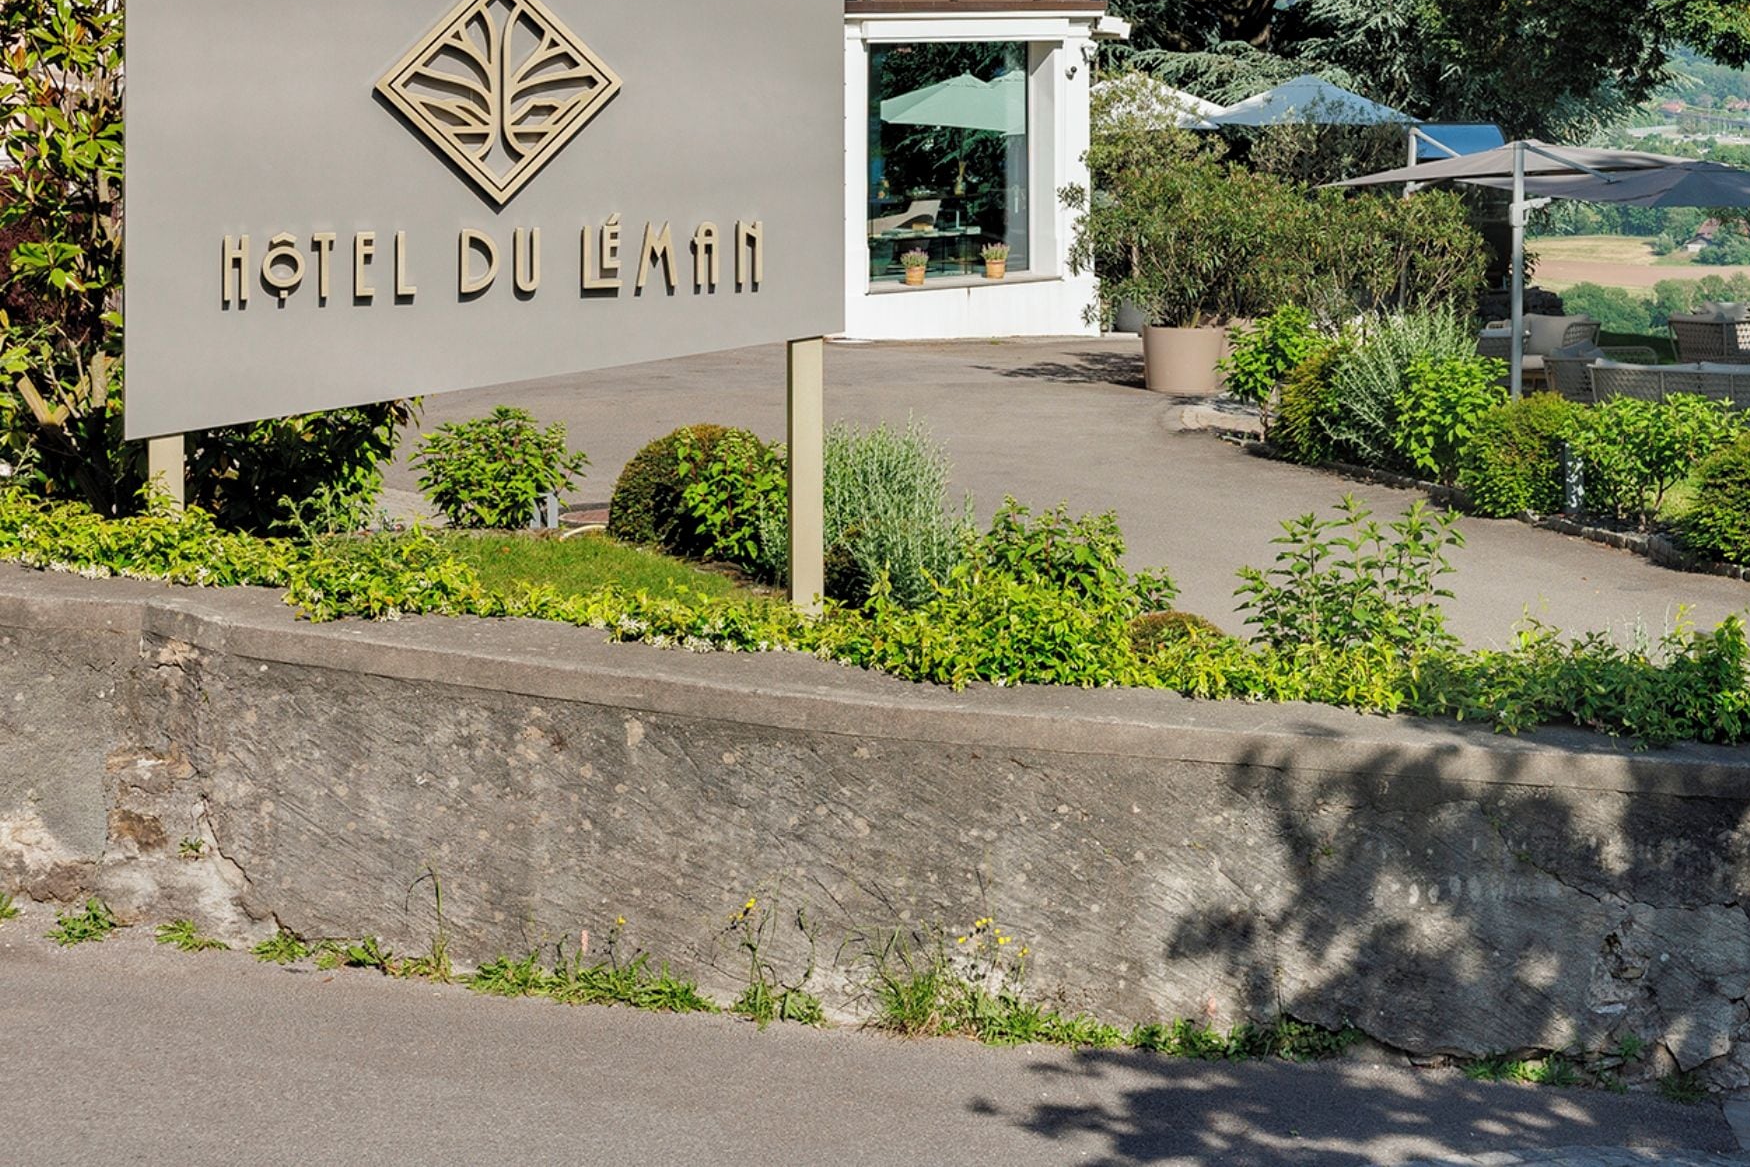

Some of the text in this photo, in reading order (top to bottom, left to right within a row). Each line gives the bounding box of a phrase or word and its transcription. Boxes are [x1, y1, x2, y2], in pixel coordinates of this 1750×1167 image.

[223, 211, 764, 301] HÔTEL DU LÉMAN
